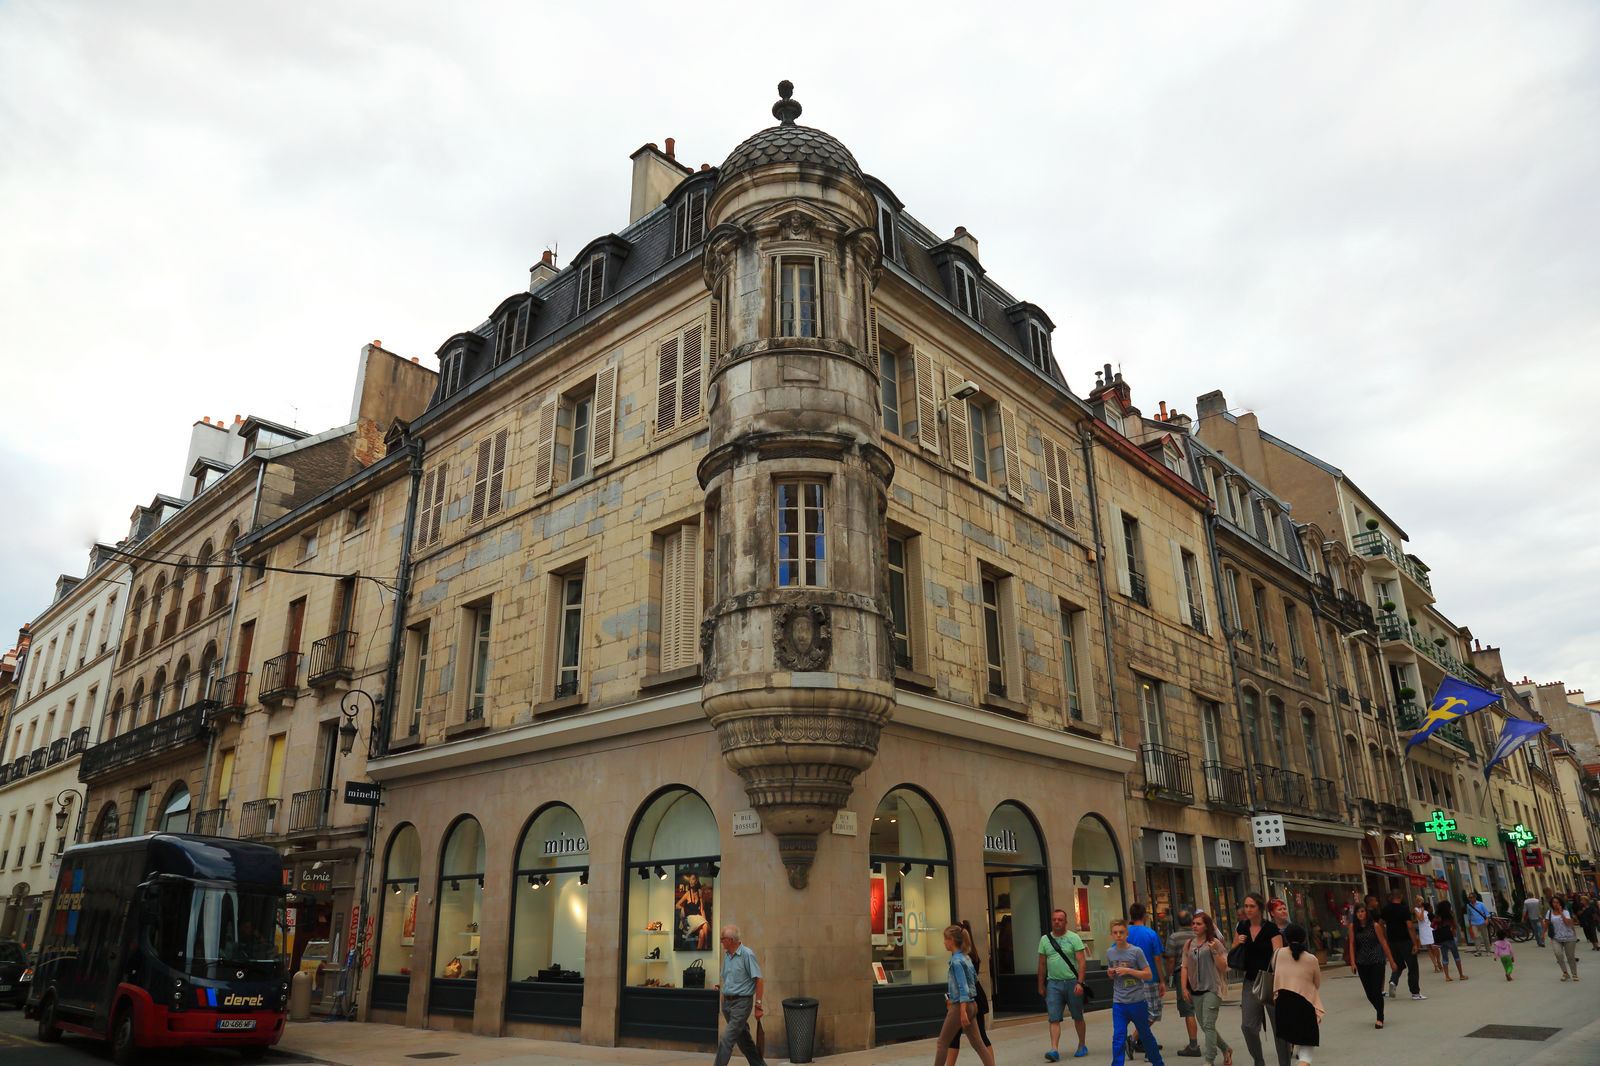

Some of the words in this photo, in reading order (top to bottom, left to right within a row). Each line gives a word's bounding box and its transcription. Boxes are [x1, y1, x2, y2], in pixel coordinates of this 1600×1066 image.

[348, 789, 380, 799] minelli
[1258, 836, 1281, 845] SIX
[302, 870, 312, 881] la
[312, 871, 331, 881] mie
[224, 994, 264, 1006] deret
